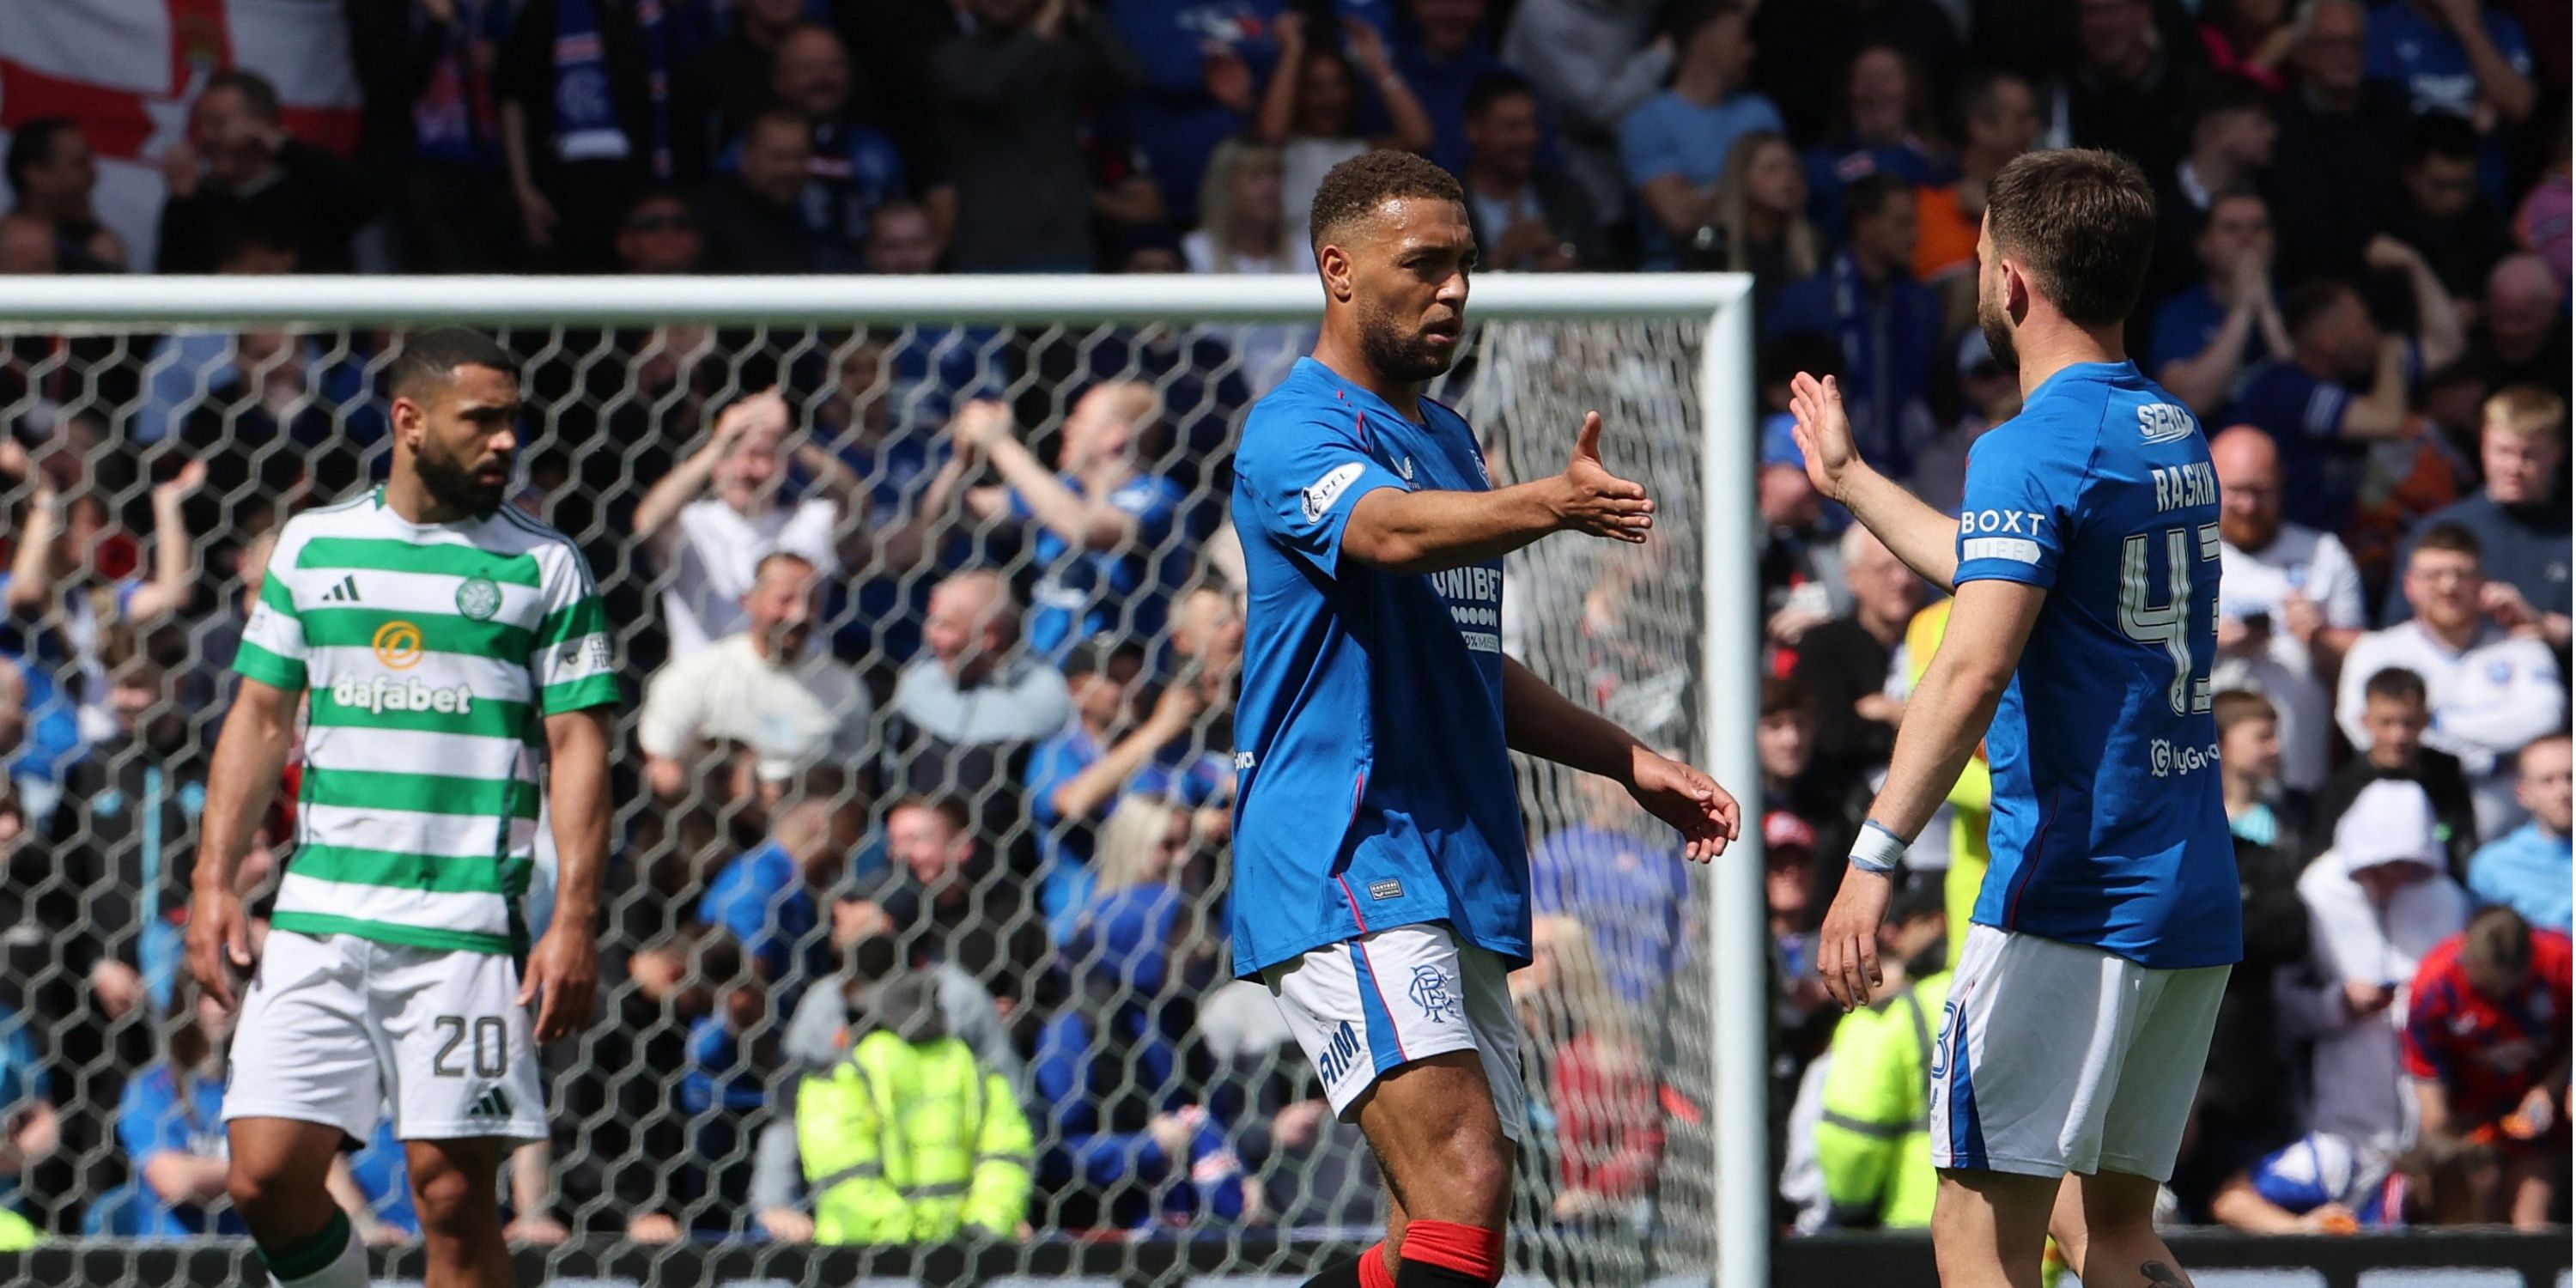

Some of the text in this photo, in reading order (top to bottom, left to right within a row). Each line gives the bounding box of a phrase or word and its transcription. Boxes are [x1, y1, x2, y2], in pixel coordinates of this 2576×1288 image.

[1312, 472, 1350, 506] SPFL
[2151, 461, 2215, 513] RASKIN
[1961, 509, 2045, 537] BOXT
[1431, 567, 1502, 603] UNIBET
[2117, 522, 2220, 718] 43
[333, 673, 471, 714] dafabet
[434, 1016, 507, 1078] 20
[1321, 1020, 1360, 1094] AIM
